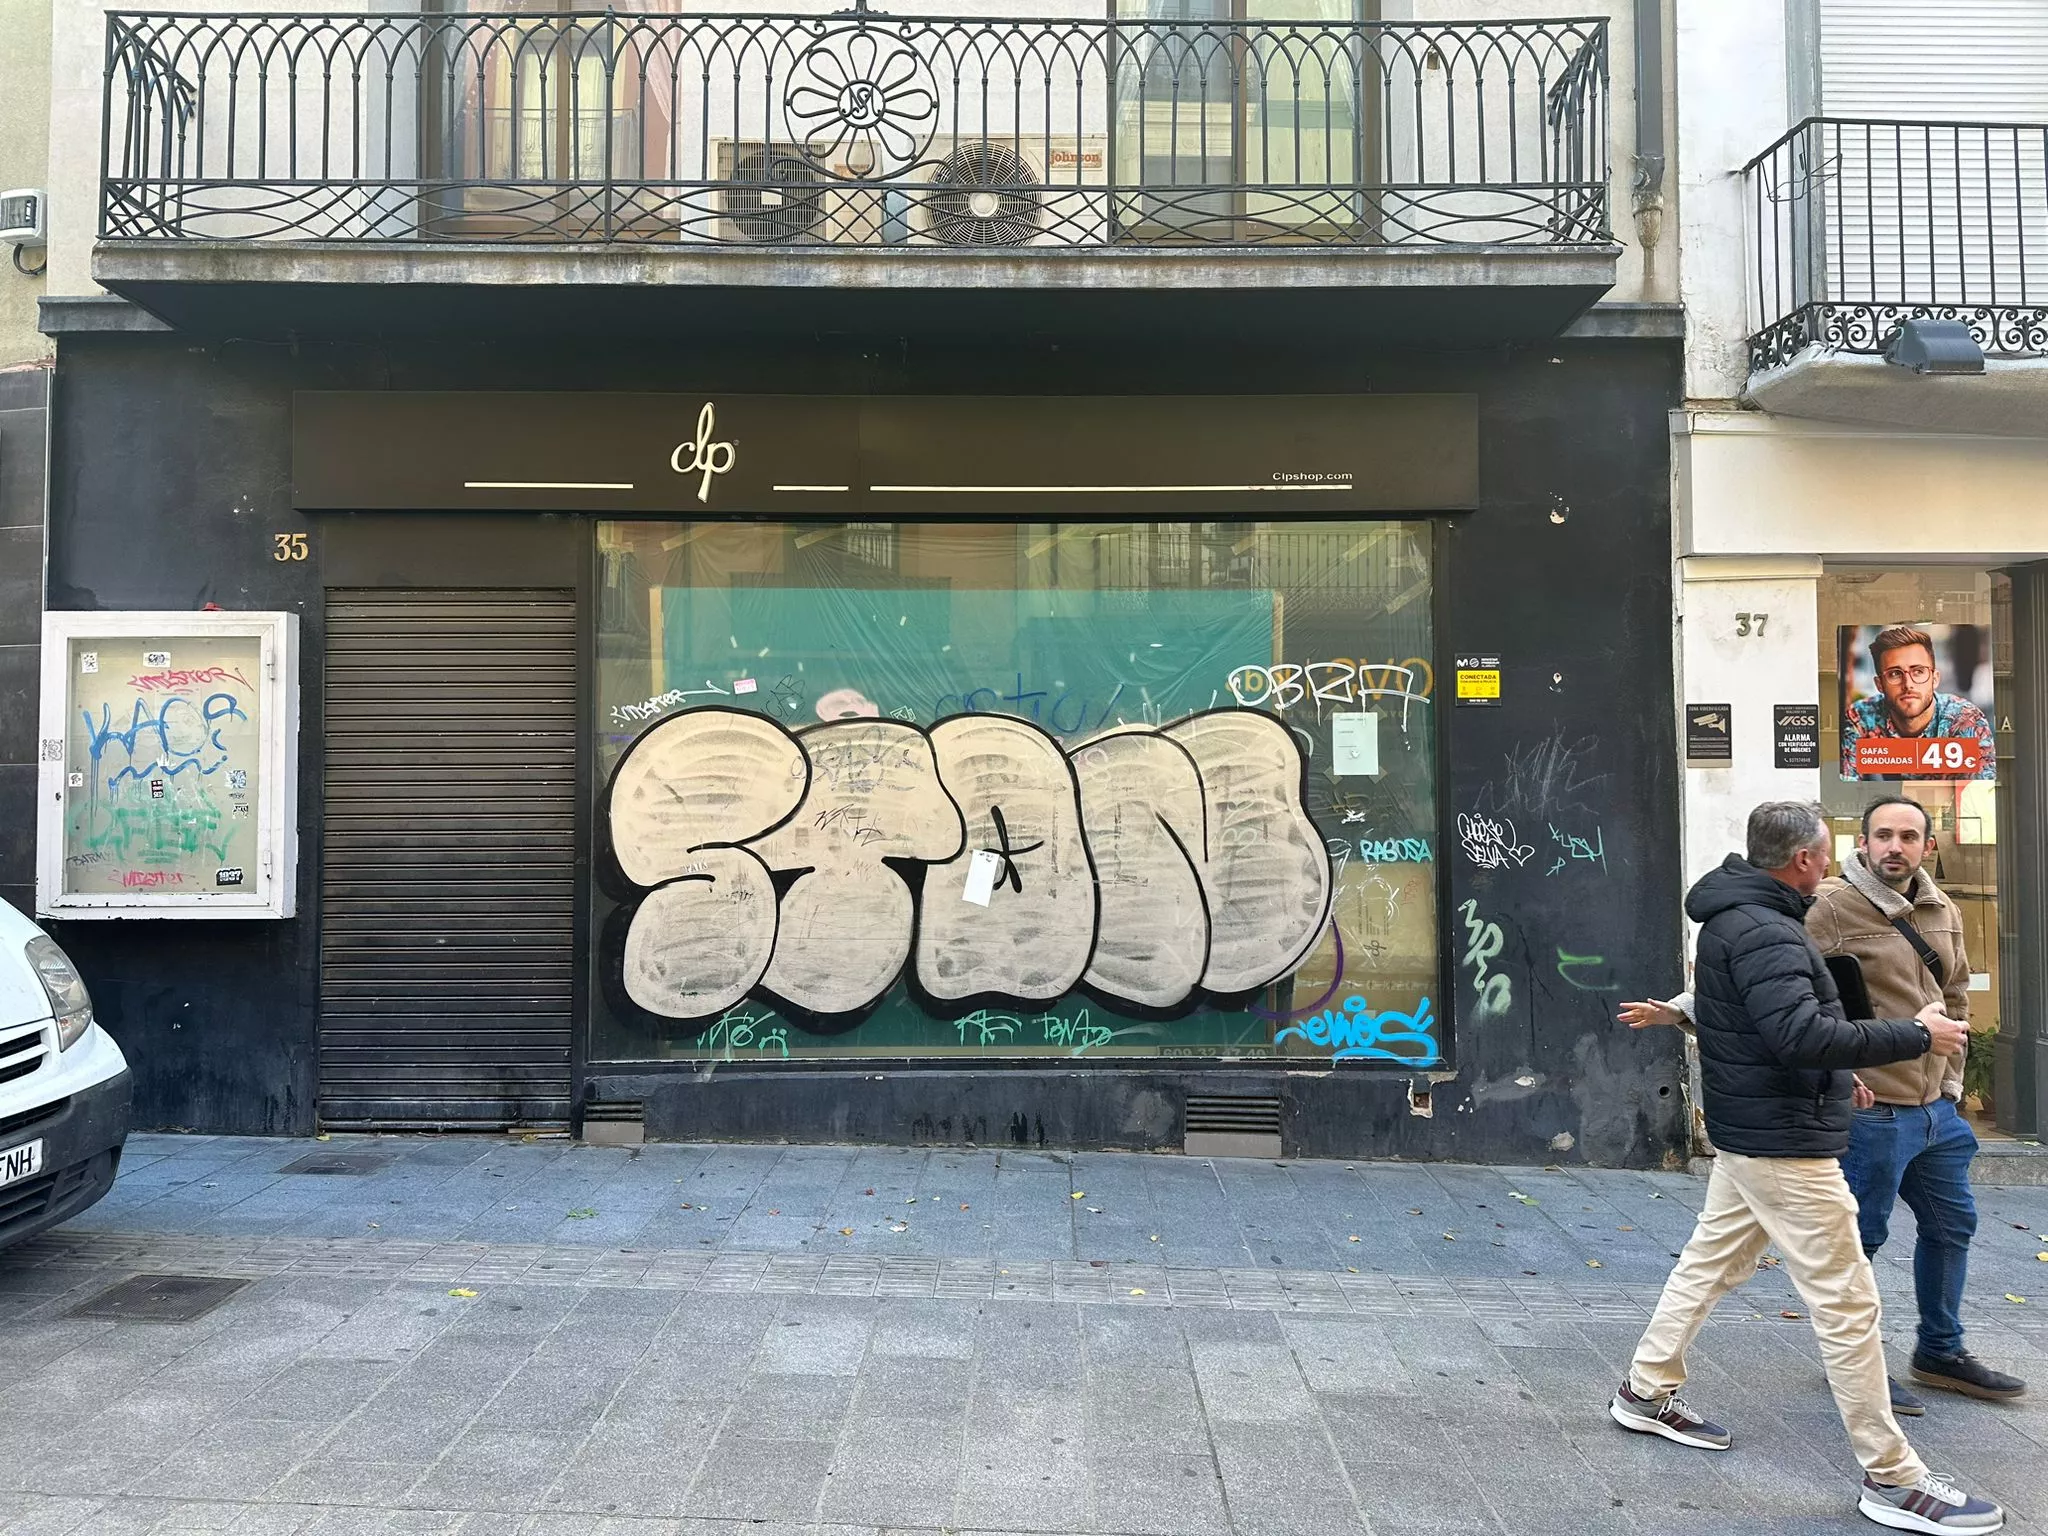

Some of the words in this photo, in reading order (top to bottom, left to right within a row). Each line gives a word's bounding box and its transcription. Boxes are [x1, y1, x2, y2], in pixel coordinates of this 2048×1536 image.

[1272, 472, 1353, 482] Clpshop.com
[273, 533, 309, 561] 35
[1735, 612, 1769, 637] 37
[1790, 715, 1816, 726] GSS
[1784, 733, 1811, 742] ALARMA
[1860, 747, 1889, 755] GAFAS
[1921, 742, 1976, 769] 49€
[1860, 757, 1913, 765] GRADUADAS
[1360, 837, 1433, 863] RABOSA
[0, 1146, 33, 1180] NH
